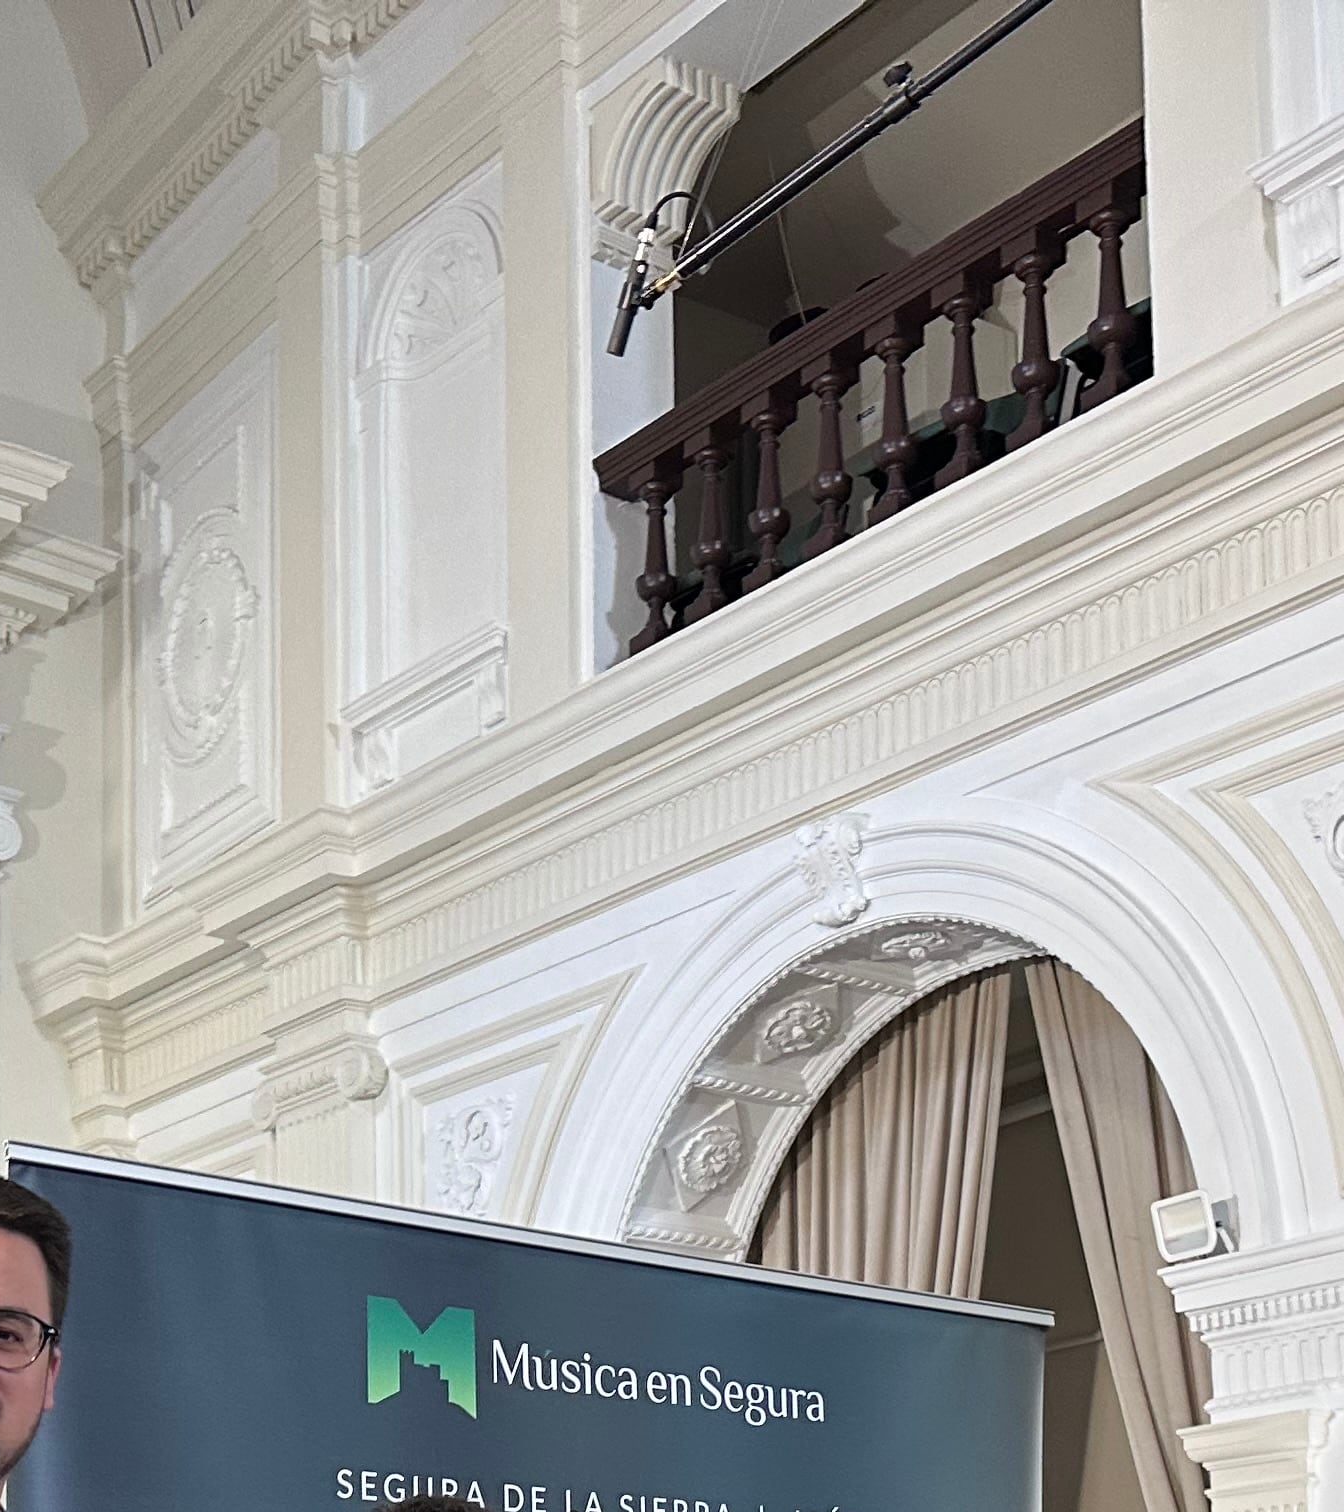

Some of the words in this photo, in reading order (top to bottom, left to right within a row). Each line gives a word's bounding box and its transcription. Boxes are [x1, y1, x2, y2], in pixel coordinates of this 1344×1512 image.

[647, 1369, 692, 1407] en
[699, 1365, 826, 1427] Segura
[336, 1468, 486, 1509] SEGURA
